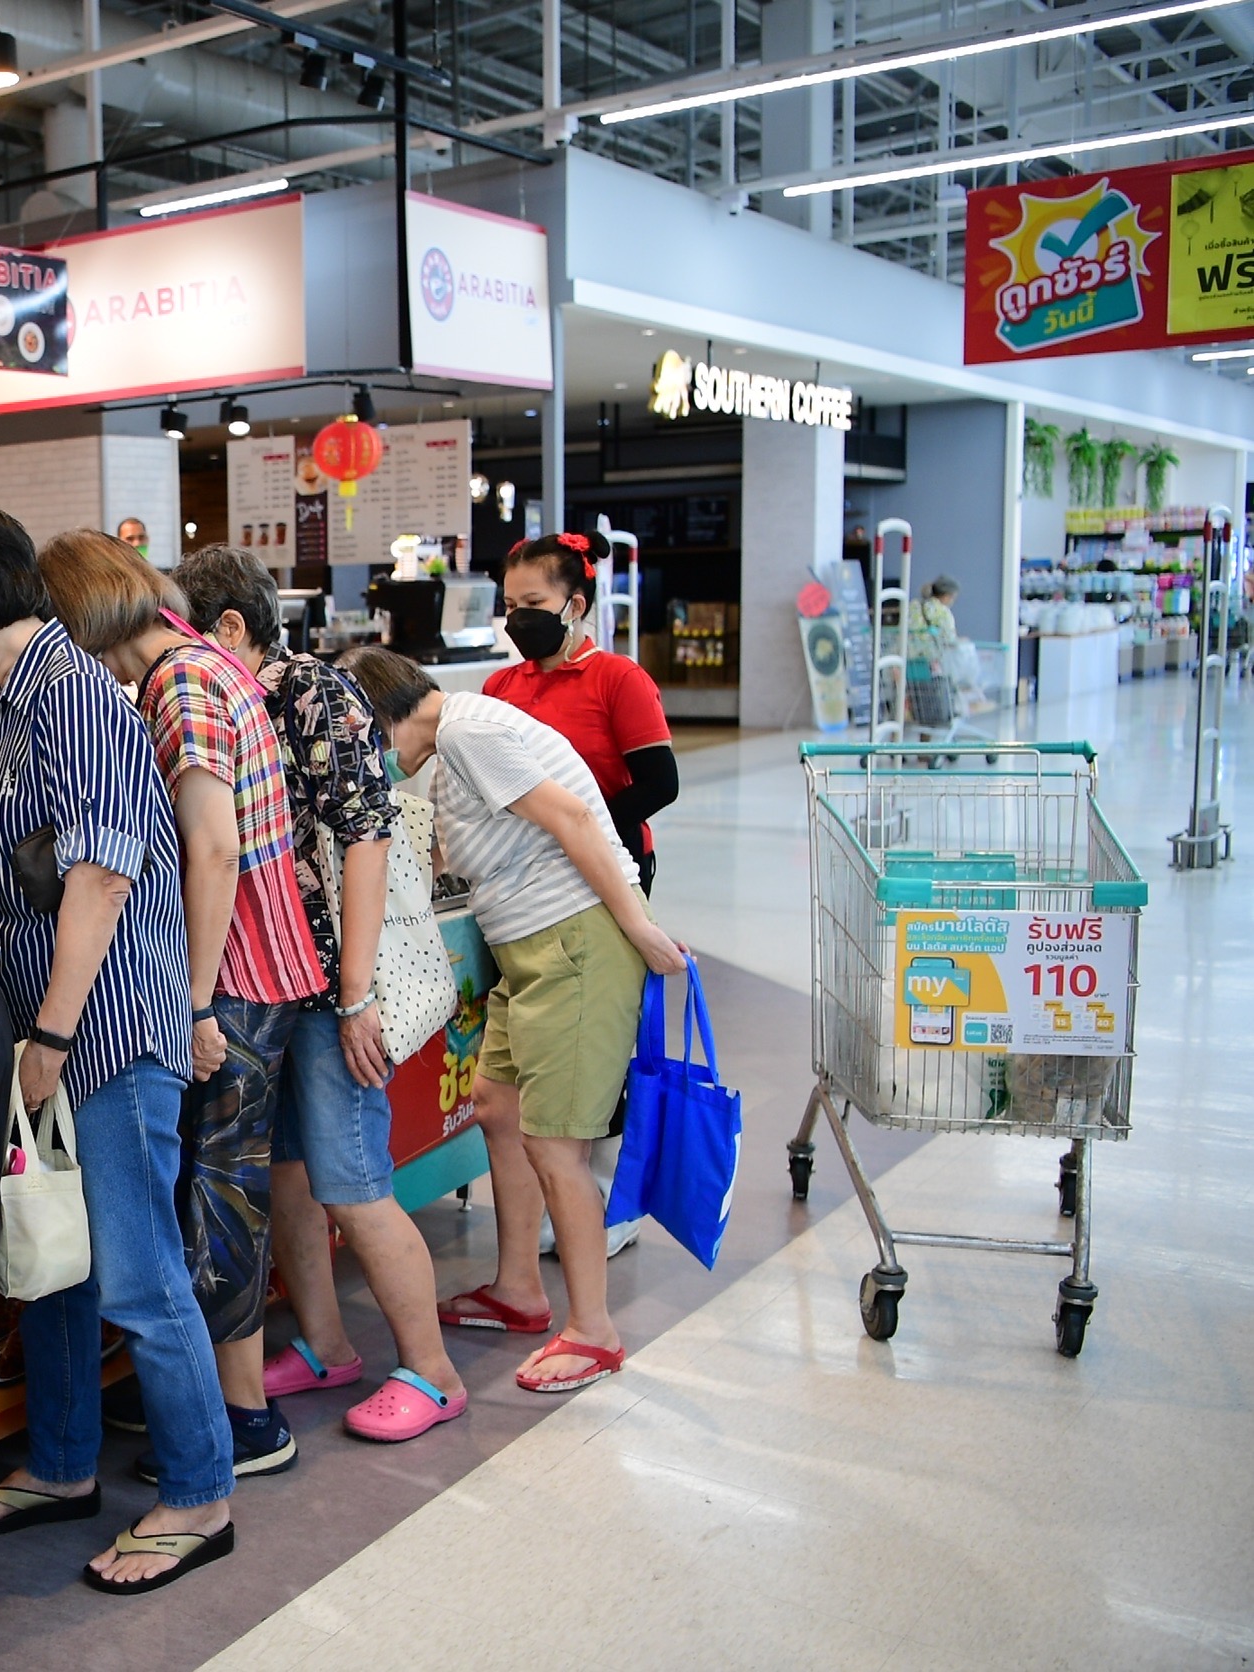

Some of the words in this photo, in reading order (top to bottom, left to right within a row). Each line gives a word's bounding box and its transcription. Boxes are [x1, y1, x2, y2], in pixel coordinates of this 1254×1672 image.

[457, 272, 537, 309] ARABITIA
[1001, 242, 1130, 321] ถูกชัวร์
[83, 275, 247, 327] ARABITIA
[1043, 291, 1097, 334] วันนี้
[693, 361, 791, 422] SOUTHERN
[792, 380, 853, 431] COFFEE
[906, 915, 1009, 933] สมัครมายโลตัส
[1028, 916, 1103, 940] รับฟรี
[1026, 940, 1102, 956] คูปองส่วนลด
[907, 975, 948, 998] my
[1024, 964, 1097, 998] 110
